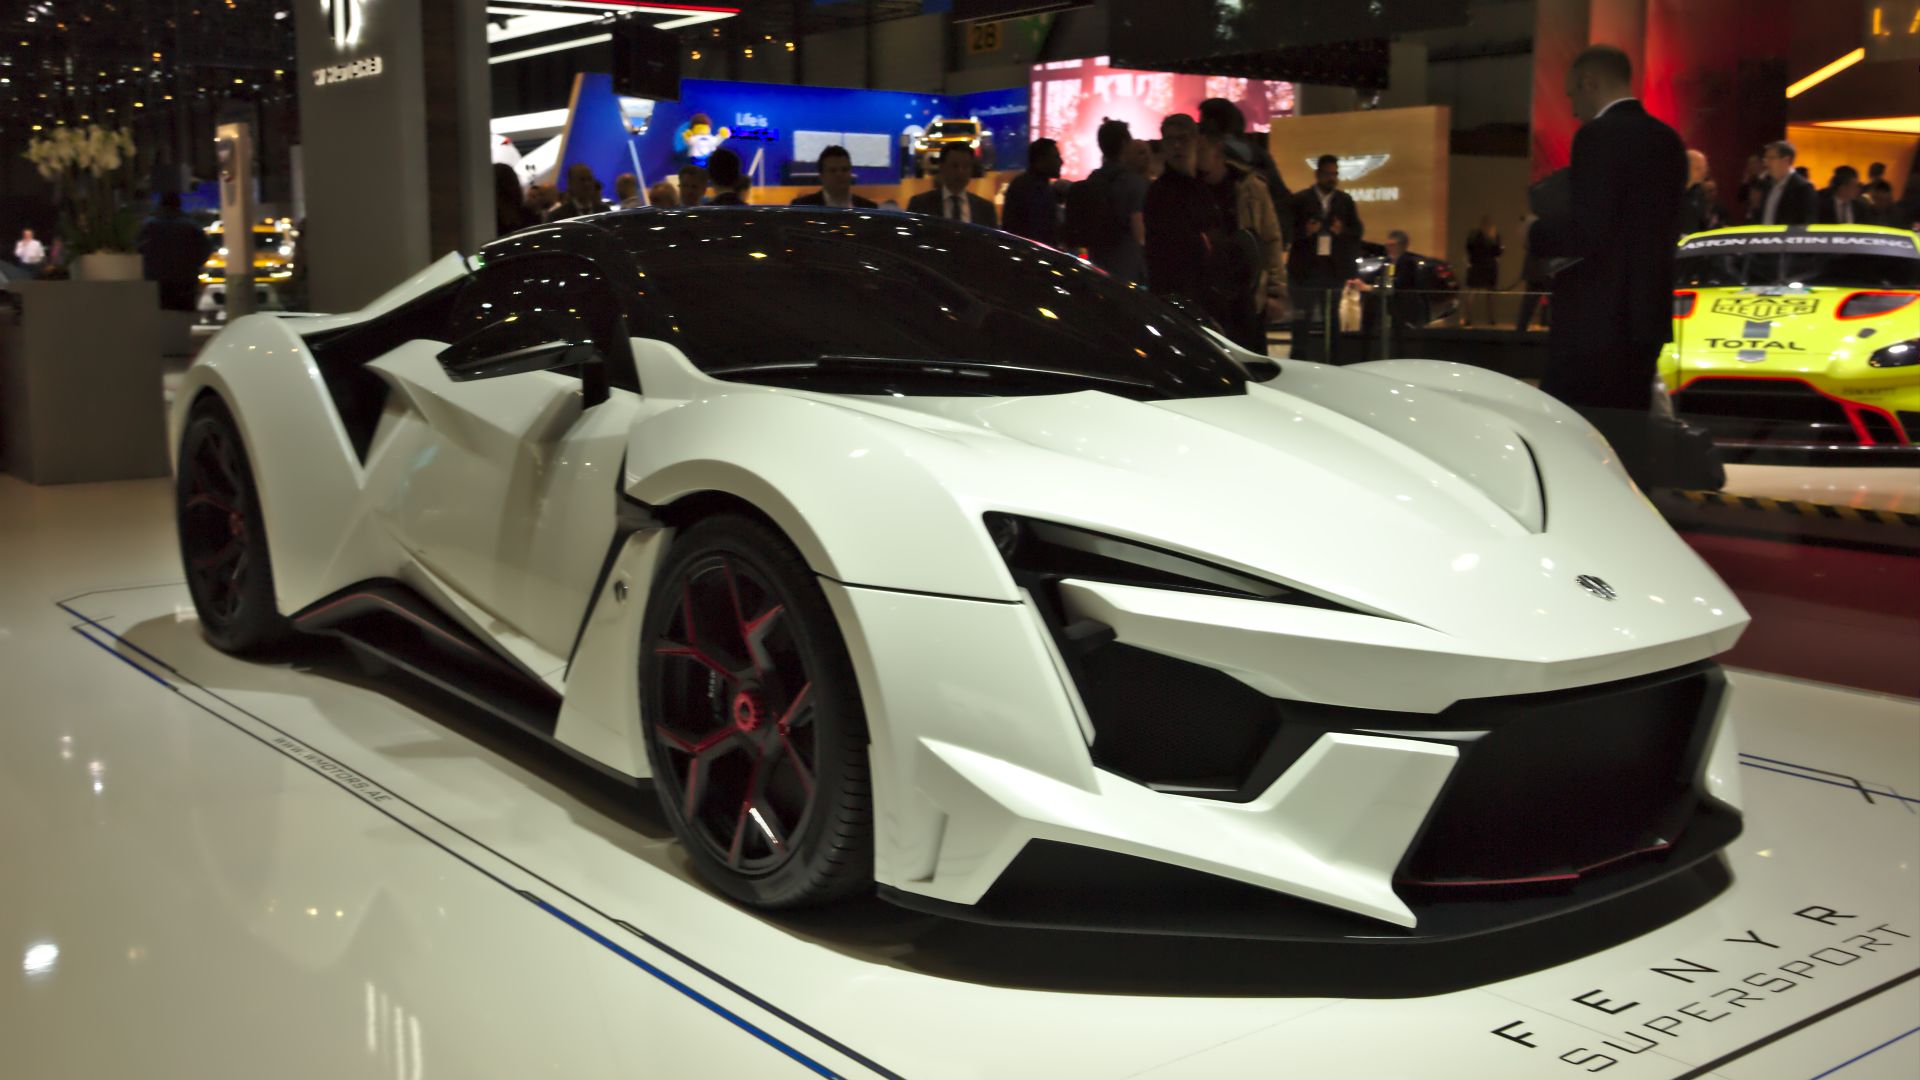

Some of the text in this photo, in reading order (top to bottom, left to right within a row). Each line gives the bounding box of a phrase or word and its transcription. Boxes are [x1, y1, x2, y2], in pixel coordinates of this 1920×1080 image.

[1681, 237, 1914, 250] ASTON MARTIN RACING
[1721, 297, 1808, 306] TAG
[1719, 304, 1809, 317] HEUER
[1703, 338, 1806, 351] TOTAL
[1559, 923, 1912, 1073] SUPERSPORT
